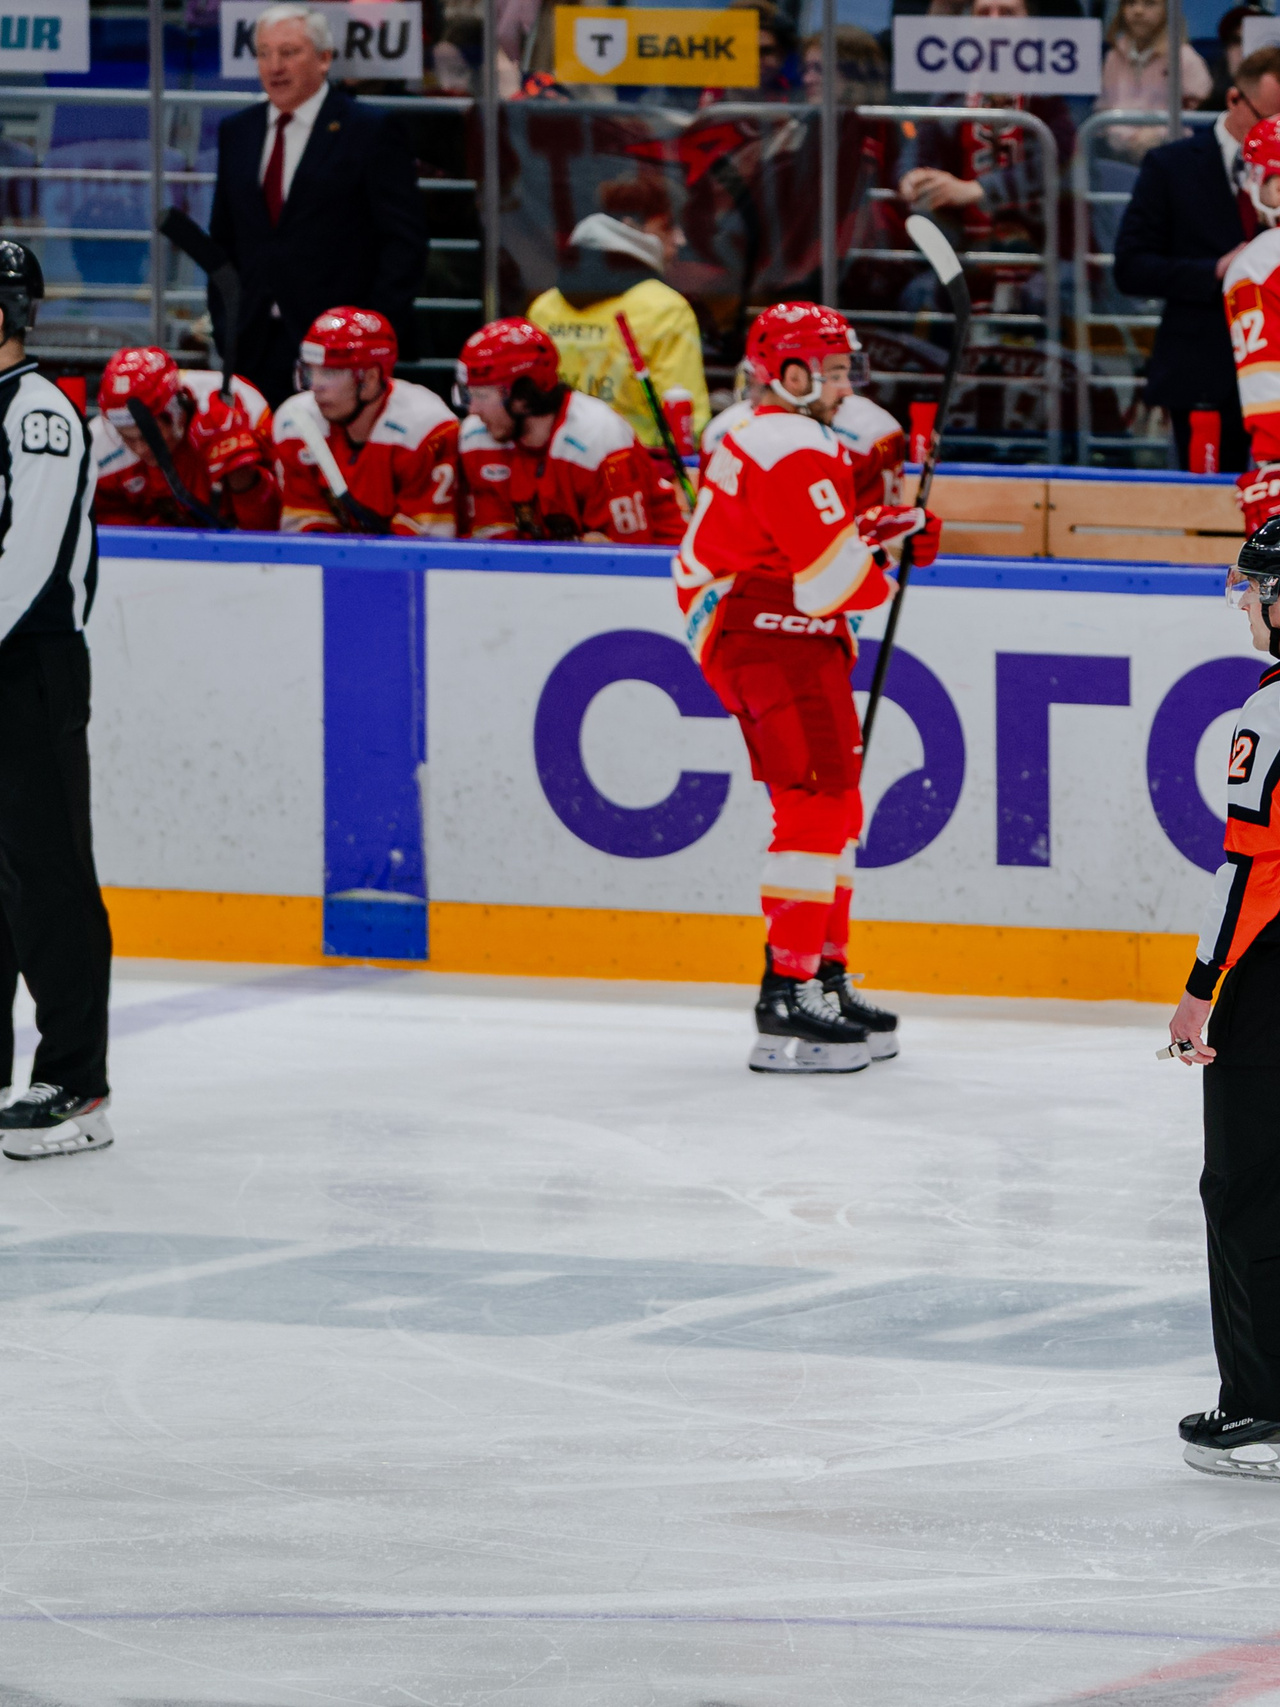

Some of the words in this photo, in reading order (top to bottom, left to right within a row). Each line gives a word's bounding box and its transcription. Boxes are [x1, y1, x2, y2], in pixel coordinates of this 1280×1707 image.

[637, 34, 735, 60] БАНК
[1230, 309, 1268, 363] 92
[22, 411, 70, 453] 86
[808, 478, 846, 525] 9
[753, 612, 837, 634] CCM
